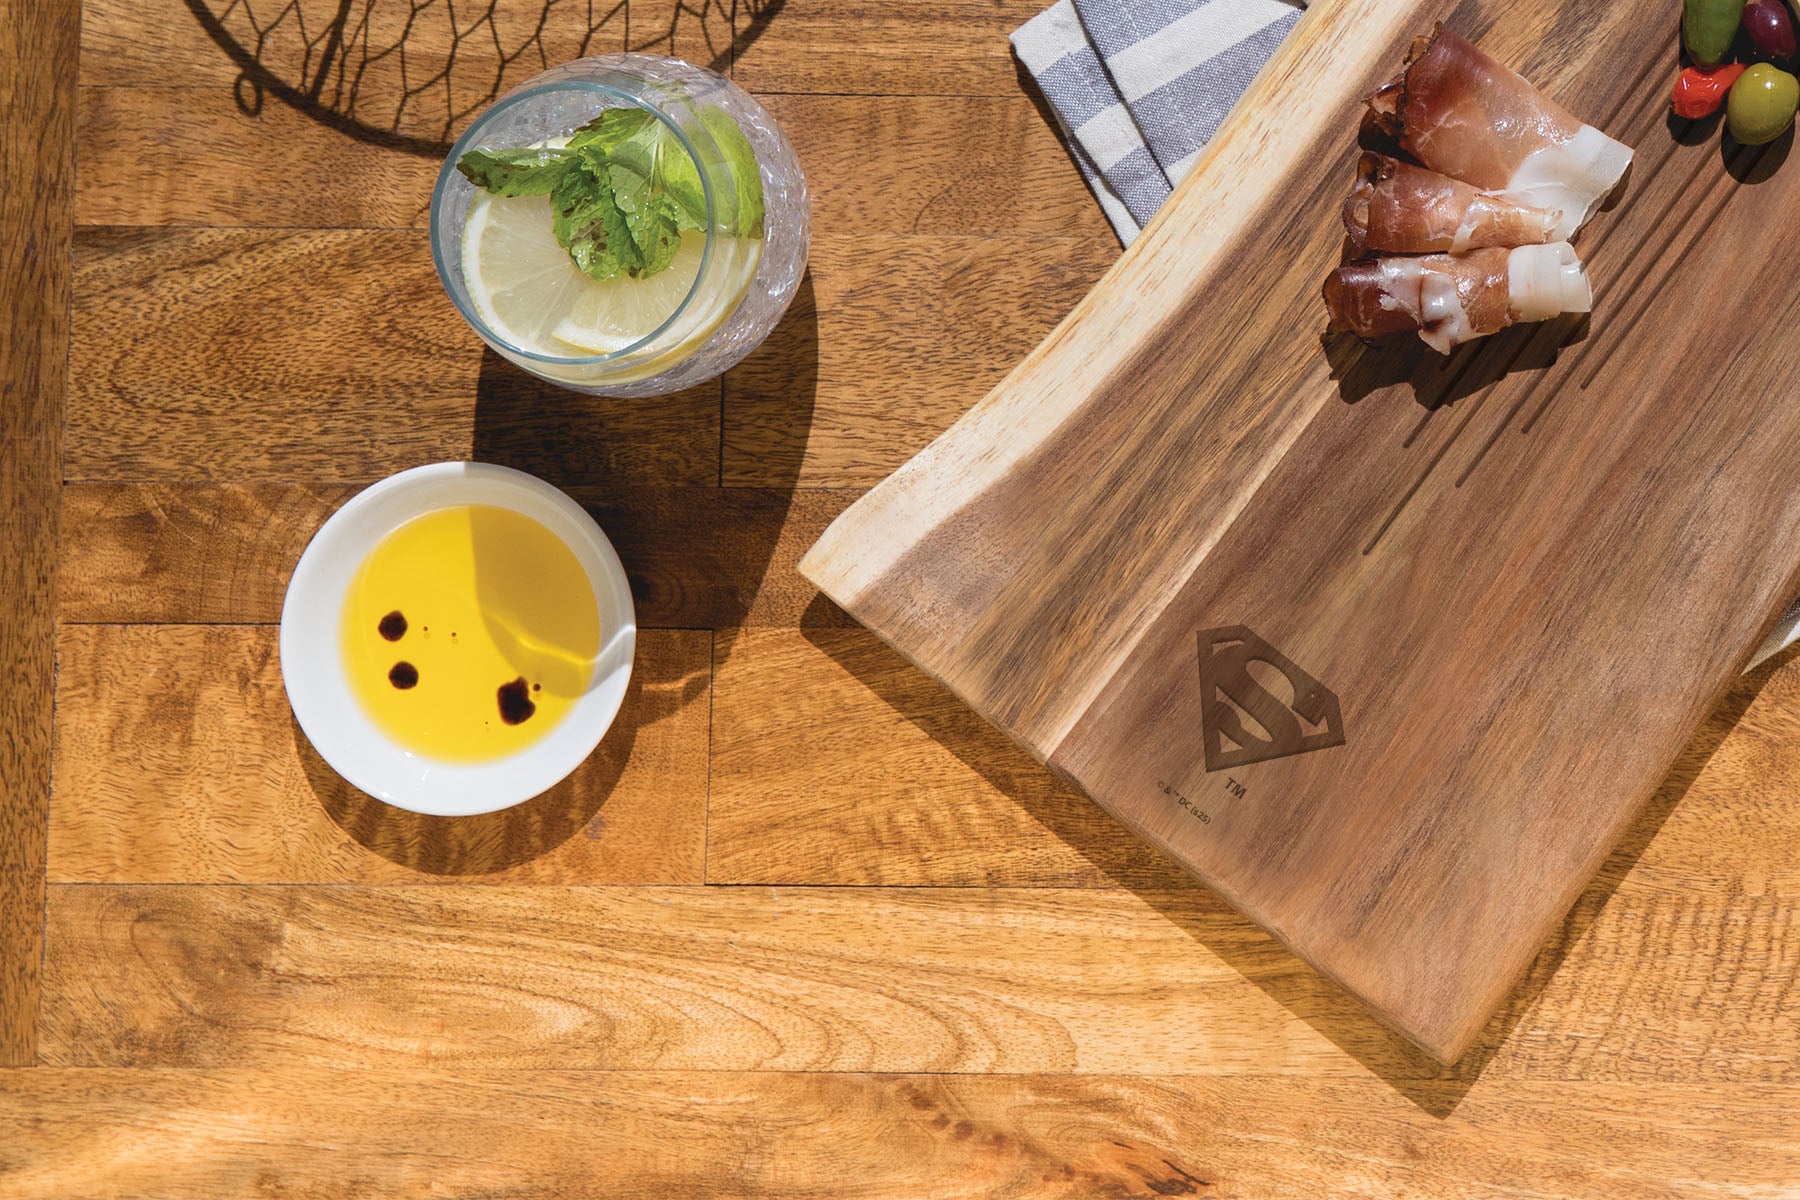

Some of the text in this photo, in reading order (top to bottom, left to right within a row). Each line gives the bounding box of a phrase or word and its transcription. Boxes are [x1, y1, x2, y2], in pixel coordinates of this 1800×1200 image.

[1203, 636, 1329, 757] S
[1225, 777, 1247, 800] TM
[1178, 796, 1193, 810] DC
